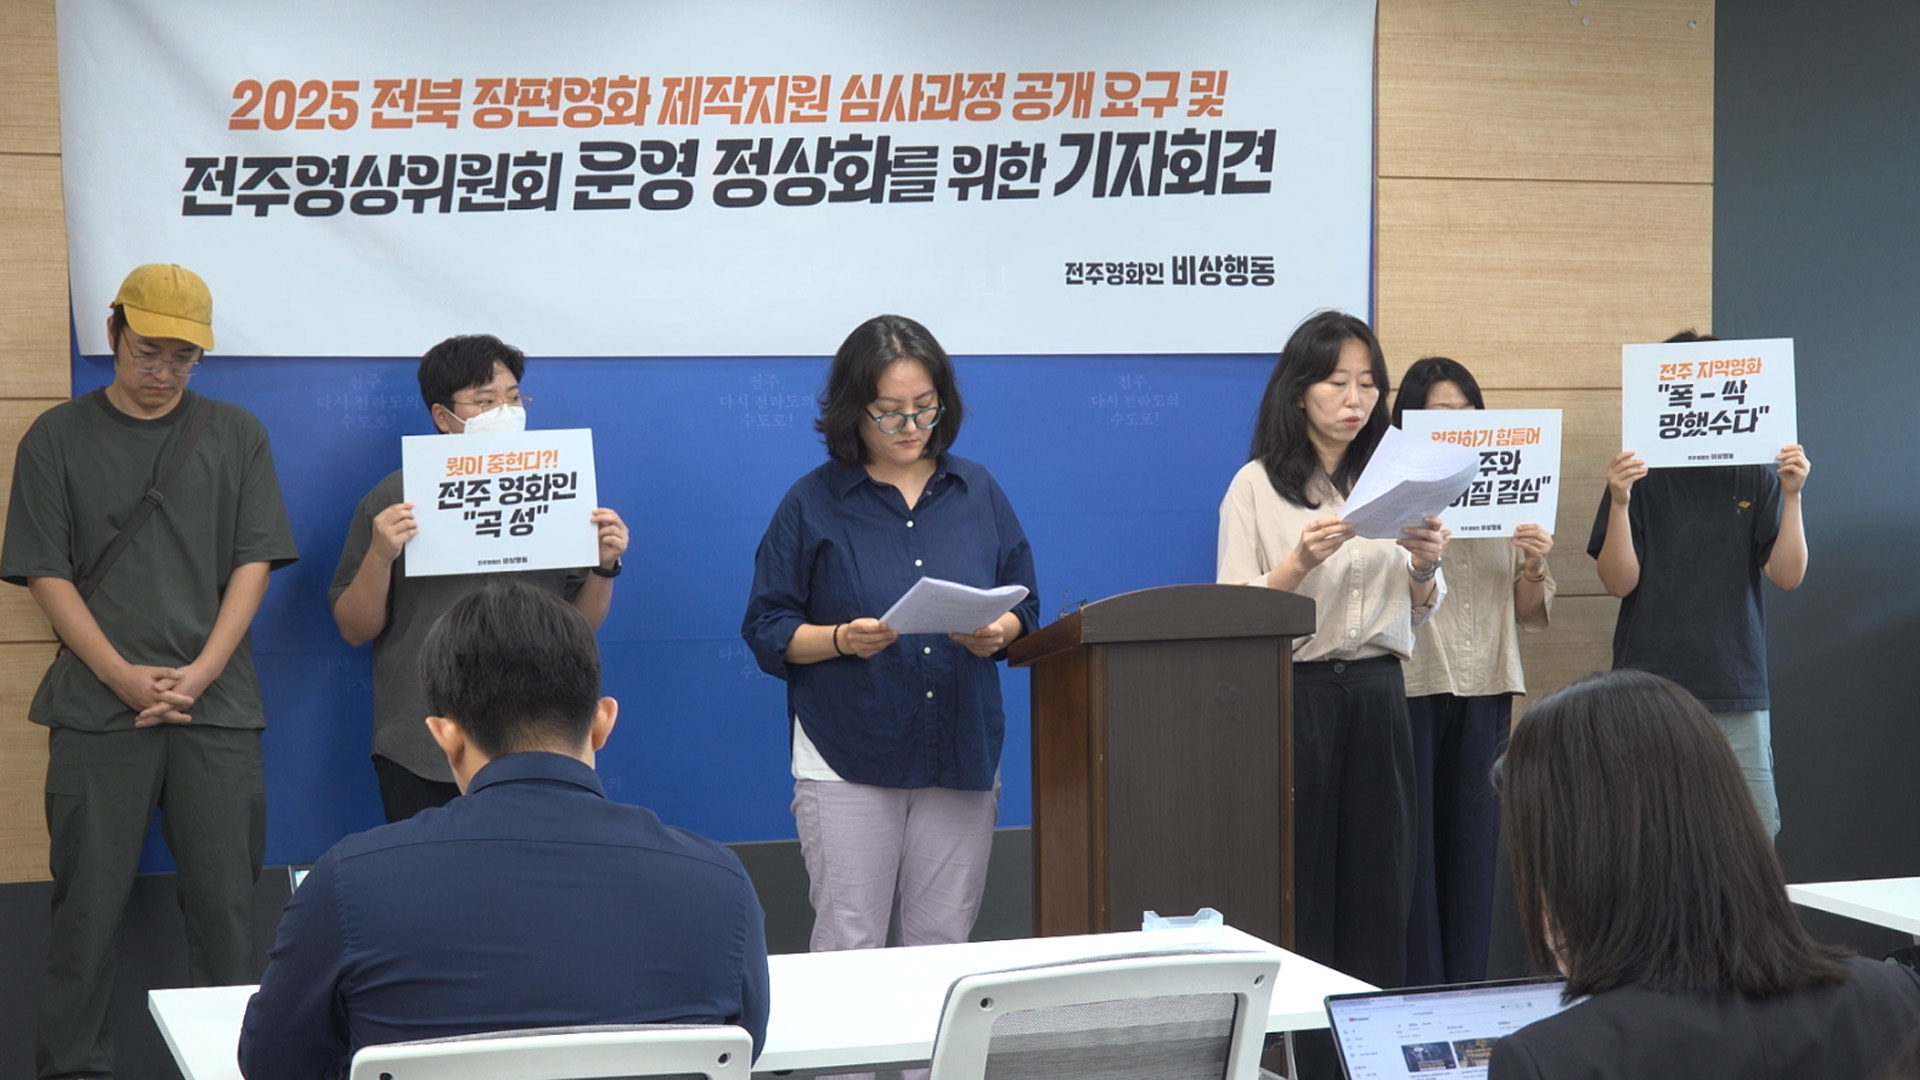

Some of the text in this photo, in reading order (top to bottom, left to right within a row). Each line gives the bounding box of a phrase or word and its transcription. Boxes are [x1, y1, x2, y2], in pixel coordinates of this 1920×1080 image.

[228, 70, 1229, 130] 2025 전북 장편영화 제작지원 심사과정 공개 요구 및
[182, 128, 1276, 217] 전주영상위원회 운영 정상화를 위한 기자회견
[1066, 255, 1276, 286] 전주영화인 비상행동
[1659, 357, 1762, 381] 전주 지역영화
[720, 393, 748, 409] 다시
[1091, 393, 1118, 408] 다시
[1658, 383, 1694, 408] "폭
[1721, 380, 1748, 405] 싹
[1496, 427, 1541, 446] 힘들어
[1658, 405, 1770, 439] 망했수다"
[446, 449, 558, 477] 뭣이 중헌디?!
[1479, 450, 1521, 477] 주와
[438, 471, 577, 510] 전주 영화인
[1497, 475, 1551, 505] 결심"
[464, 504, 549, 538] "곡 성"
